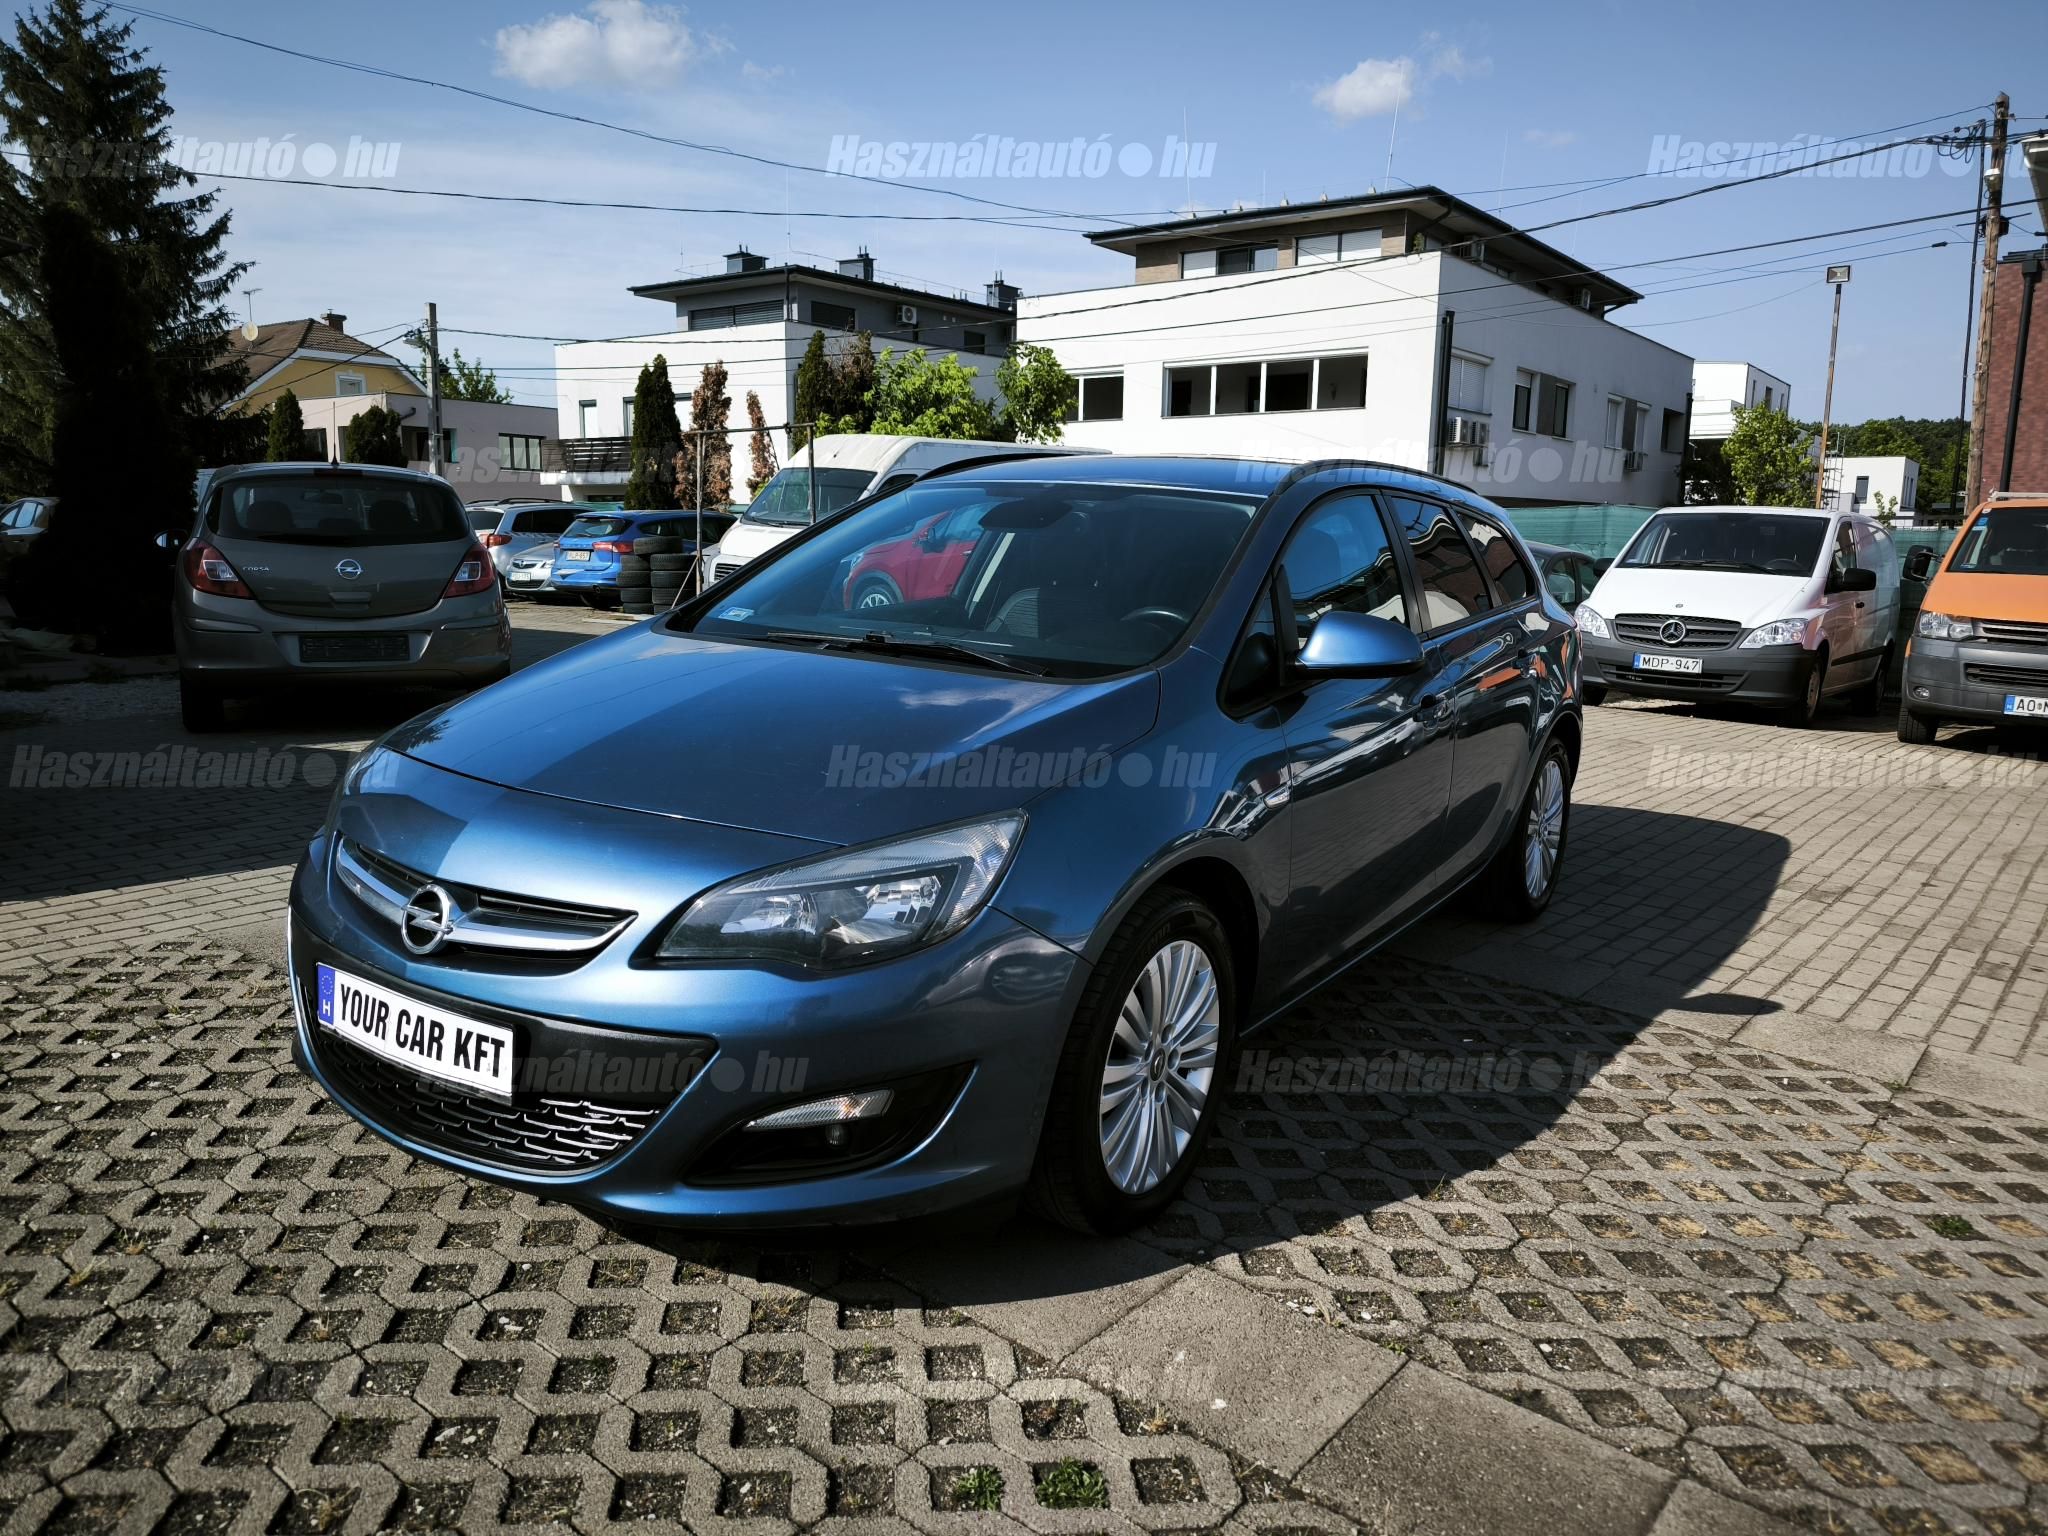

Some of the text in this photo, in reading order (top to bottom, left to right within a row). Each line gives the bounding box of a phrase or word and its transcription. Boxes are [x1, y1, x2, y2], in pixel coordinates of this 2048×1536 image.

[1642, 657, 1698, 670] MDP-947
[322, 999, 331, 1016] H
[341, 984, 505, 1078] YOUR CAR KFT
